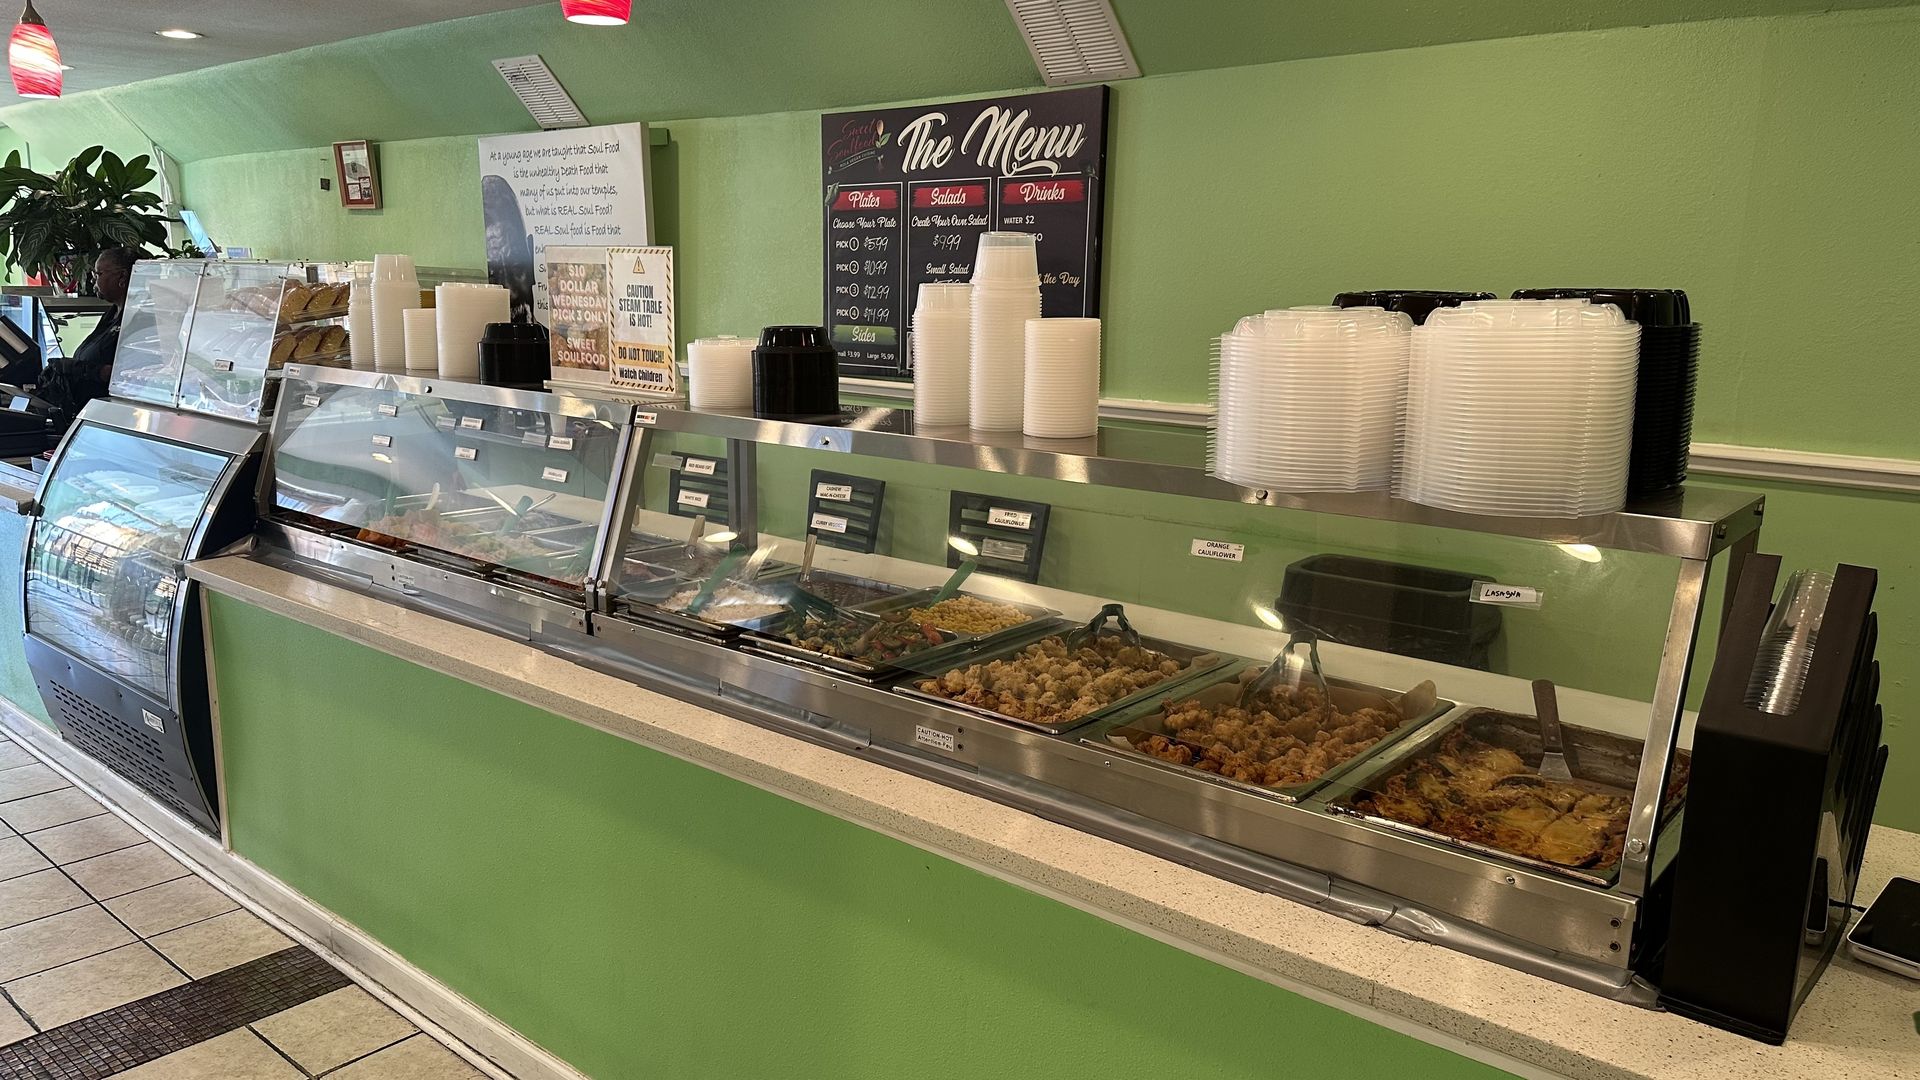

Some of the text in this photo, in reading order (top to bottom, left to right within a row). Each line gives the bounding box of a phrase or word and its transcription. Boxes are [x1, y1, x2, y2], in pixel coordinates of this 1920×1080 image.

[897, 105, 1086, 177] The Menu
[489, 151, 497, 160] At
[502, 150, 521, 166] young
[523, 149, 532, 162] age
[533, 150, 541, 158] we
[542, 148, 551, 157] are
[552, 145, 573, 160] taught
[573, 144, 586, 155] that
[587, 141, 603, 155] Soul
[604, 140, 620, 154] Food
[513, 162, 608, 182] is the unhealthy Death Food that
[520, 188, 538, 202] many
[539, 184, 545, 199] of
[546, 187, 554, 196] us
[554, 186, 565, 200] put
[566, 183, 579, 195] into
[580, 187, 591, 195] our
[848, 191, 880, 208] Plates
[930, 187, 966, 205] Salads
[1020, 183, 1065, 202] Drinks
[525, 203, 612, 216] but what is REAL Soul Food?
[833, 216, 896, 229] Choose Your Plate
[911, 214, 988, 227] Create Your Own Salad
[1025, 215, 1035, 224] $2
[534, 222, 621, 238] REAL Soul food is Food that
[835, 240, 849, 249] PICK
[933, 234, 961, 251] $9.99
[835, 263, 849, 272] PICK
[926, 262, 970, 274] Small Salad
[1043, 272, 1056, 284] the
[1058, 271, 1080, 287] Day
[560, 280, 599, 294] DOLLAR
[626, 284, 654, 299] CAUTION
[835, 286, 849, 294] PICK
[552, 295, 608, 309] WEDNESDAY
[619, 298, 663, 314] STEAM TABLE
[552, 308, 608, 324] PICK 3 ONLY
[836, 308, 849, 316] PICK
[629, 313, 652, 328] IS HOT!
[852, 326, 876, 342] Sides
[567, 338, 596, 350] SWEET
[558, 350, 606, 365] SOULFOOD
[618, 347, 665, 363] DO NOT TOUCH!
[866, 352, 879, 360] Large
[619, 367, 663, 383] Watch Children
[994, 518, 1025, 526] CAULIFLOWER
[1206, 541, 1229, 549] ORANGE
[1197, 549, 1236, 559] CAULIFLOWER
